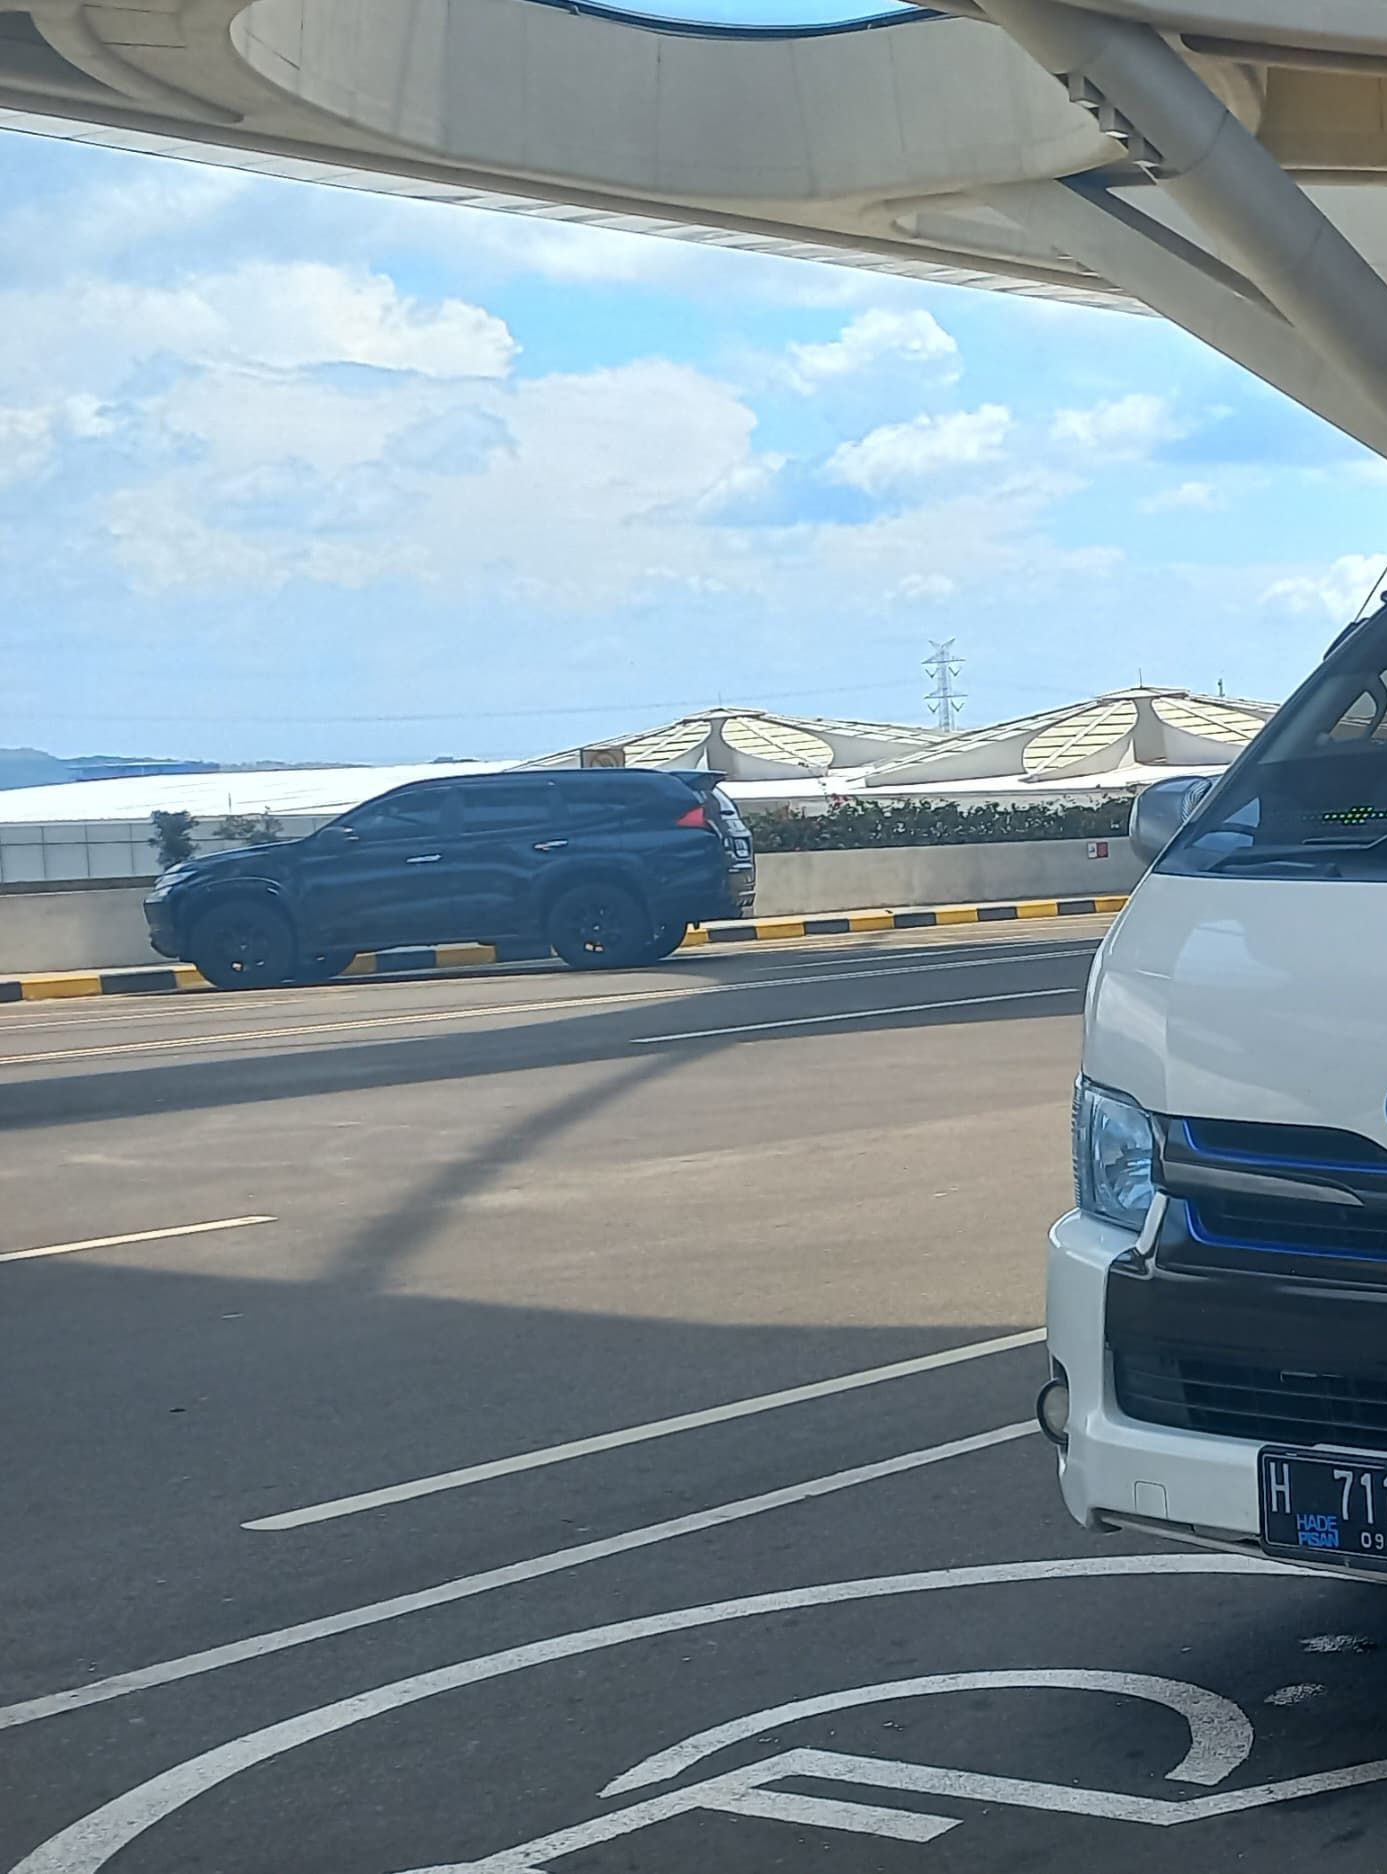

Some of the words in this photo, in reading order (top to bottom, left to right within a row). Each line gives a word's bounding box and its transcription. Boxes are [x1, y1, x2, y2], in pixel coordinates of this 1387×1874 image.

[1269, 1461, 1291, 1514] H
[1296, 1513, 1337, 1532] HADE
[1298, 1530, 1340, 1547] PISAN
